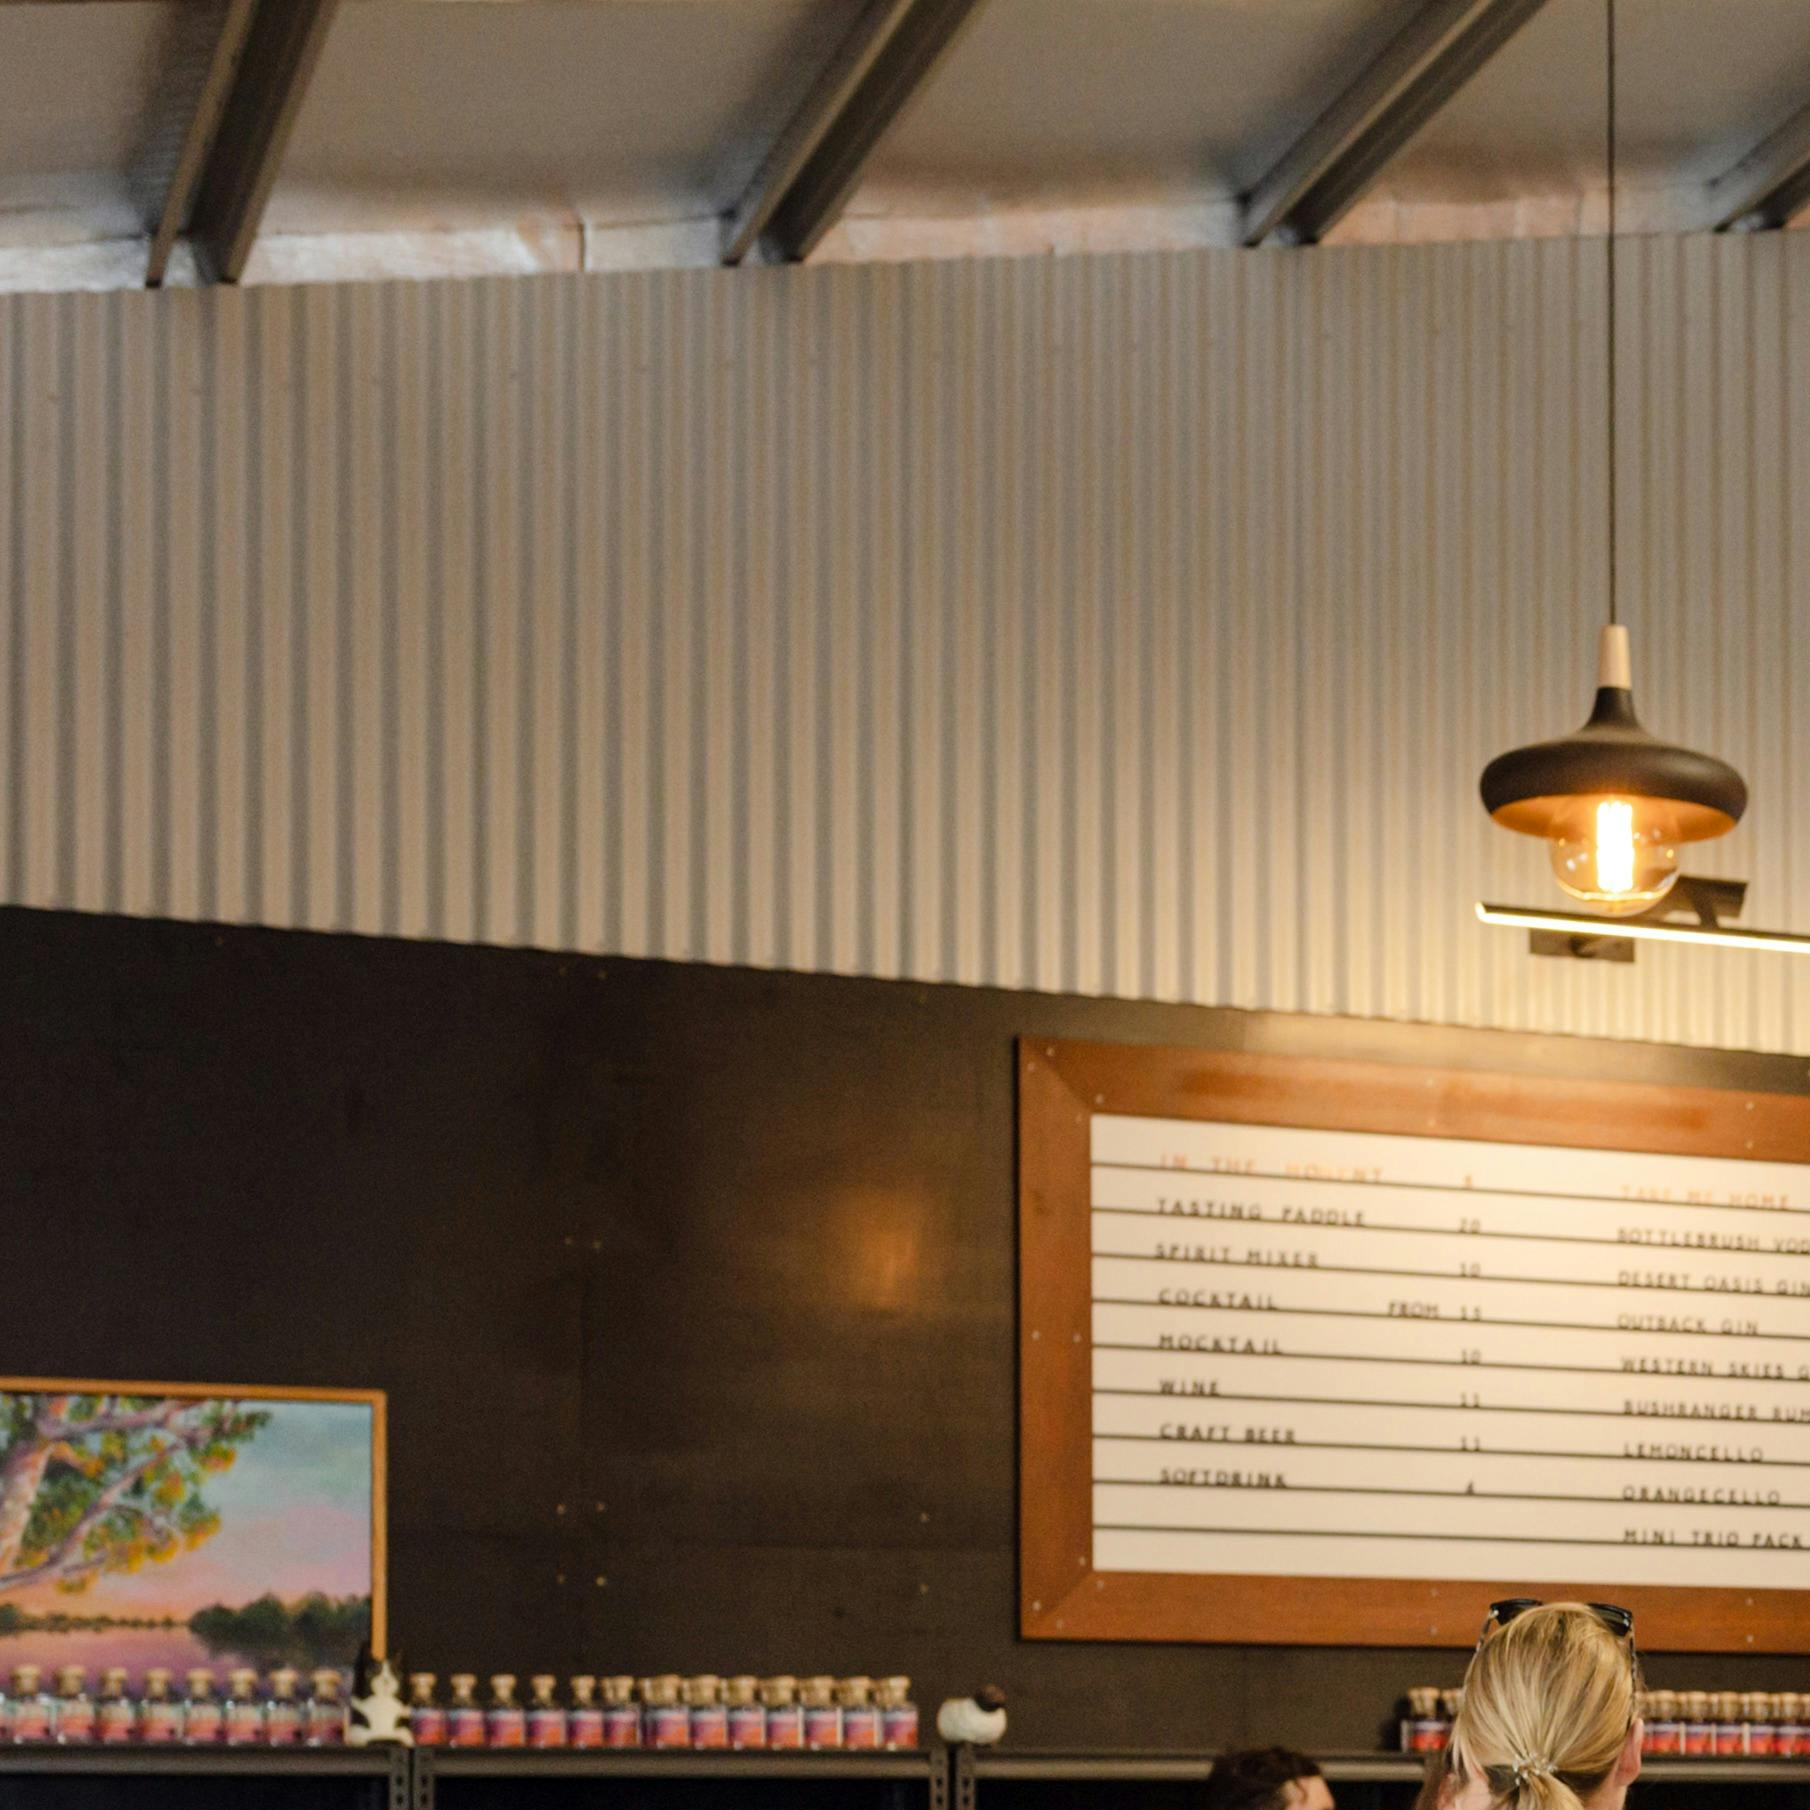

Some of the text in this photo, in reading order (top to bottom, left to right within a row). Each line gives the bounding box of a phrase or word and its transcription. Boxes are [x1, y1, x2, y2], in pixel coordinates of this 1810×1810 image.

[1157, 1198, 1262, 1222] TASTING
[1281, 1205, 1366, 1228] PADDLE
[1617, 1227, 1760, 1252] BOTTLEBRUSH
[1155, 1244, 1230, 1265] SPIRIT
[1246, 1250, 1319, 1270] MIXER
[1618, 1270, 1691, 1291] DESERT
[1704, 1275, 1764, 1295] OASIS
[1158, 1288, 1277, 1312] COCKTAIL
[1388, 1301, 1440, 1319] FROM
[1617, 1313, 1707, 1335] OUTBACK
[1720, 1319, 1759, 1337] GIN
[1158, 1334, 1283, 1356] MOCKTAIL
[1620, 1356, 1714, 1378] WESTERN
[1728, 1363, 1784, 1381] SKIES
[1159, 1381, 1221, 1398] WINE
[1623, 1399, 1758, 1422] BUSHRANGER
[1159, 1423, 1231, 1443] CRAFT
[1245, 1429, 1296, 1445] BEER
[1624, 1442, 1764, 1464] LEMONCELLO
[1159, 1468, 1289, 1490] SOFTDRINK
[1622, 1485, 1781, 1506] ORANGECELLO
[1624, 1529, 1676, 1546] MINI
[1691, 1531, 1740, 1548] TRIO
[1752, 1534, 1805, 1551] PACK
